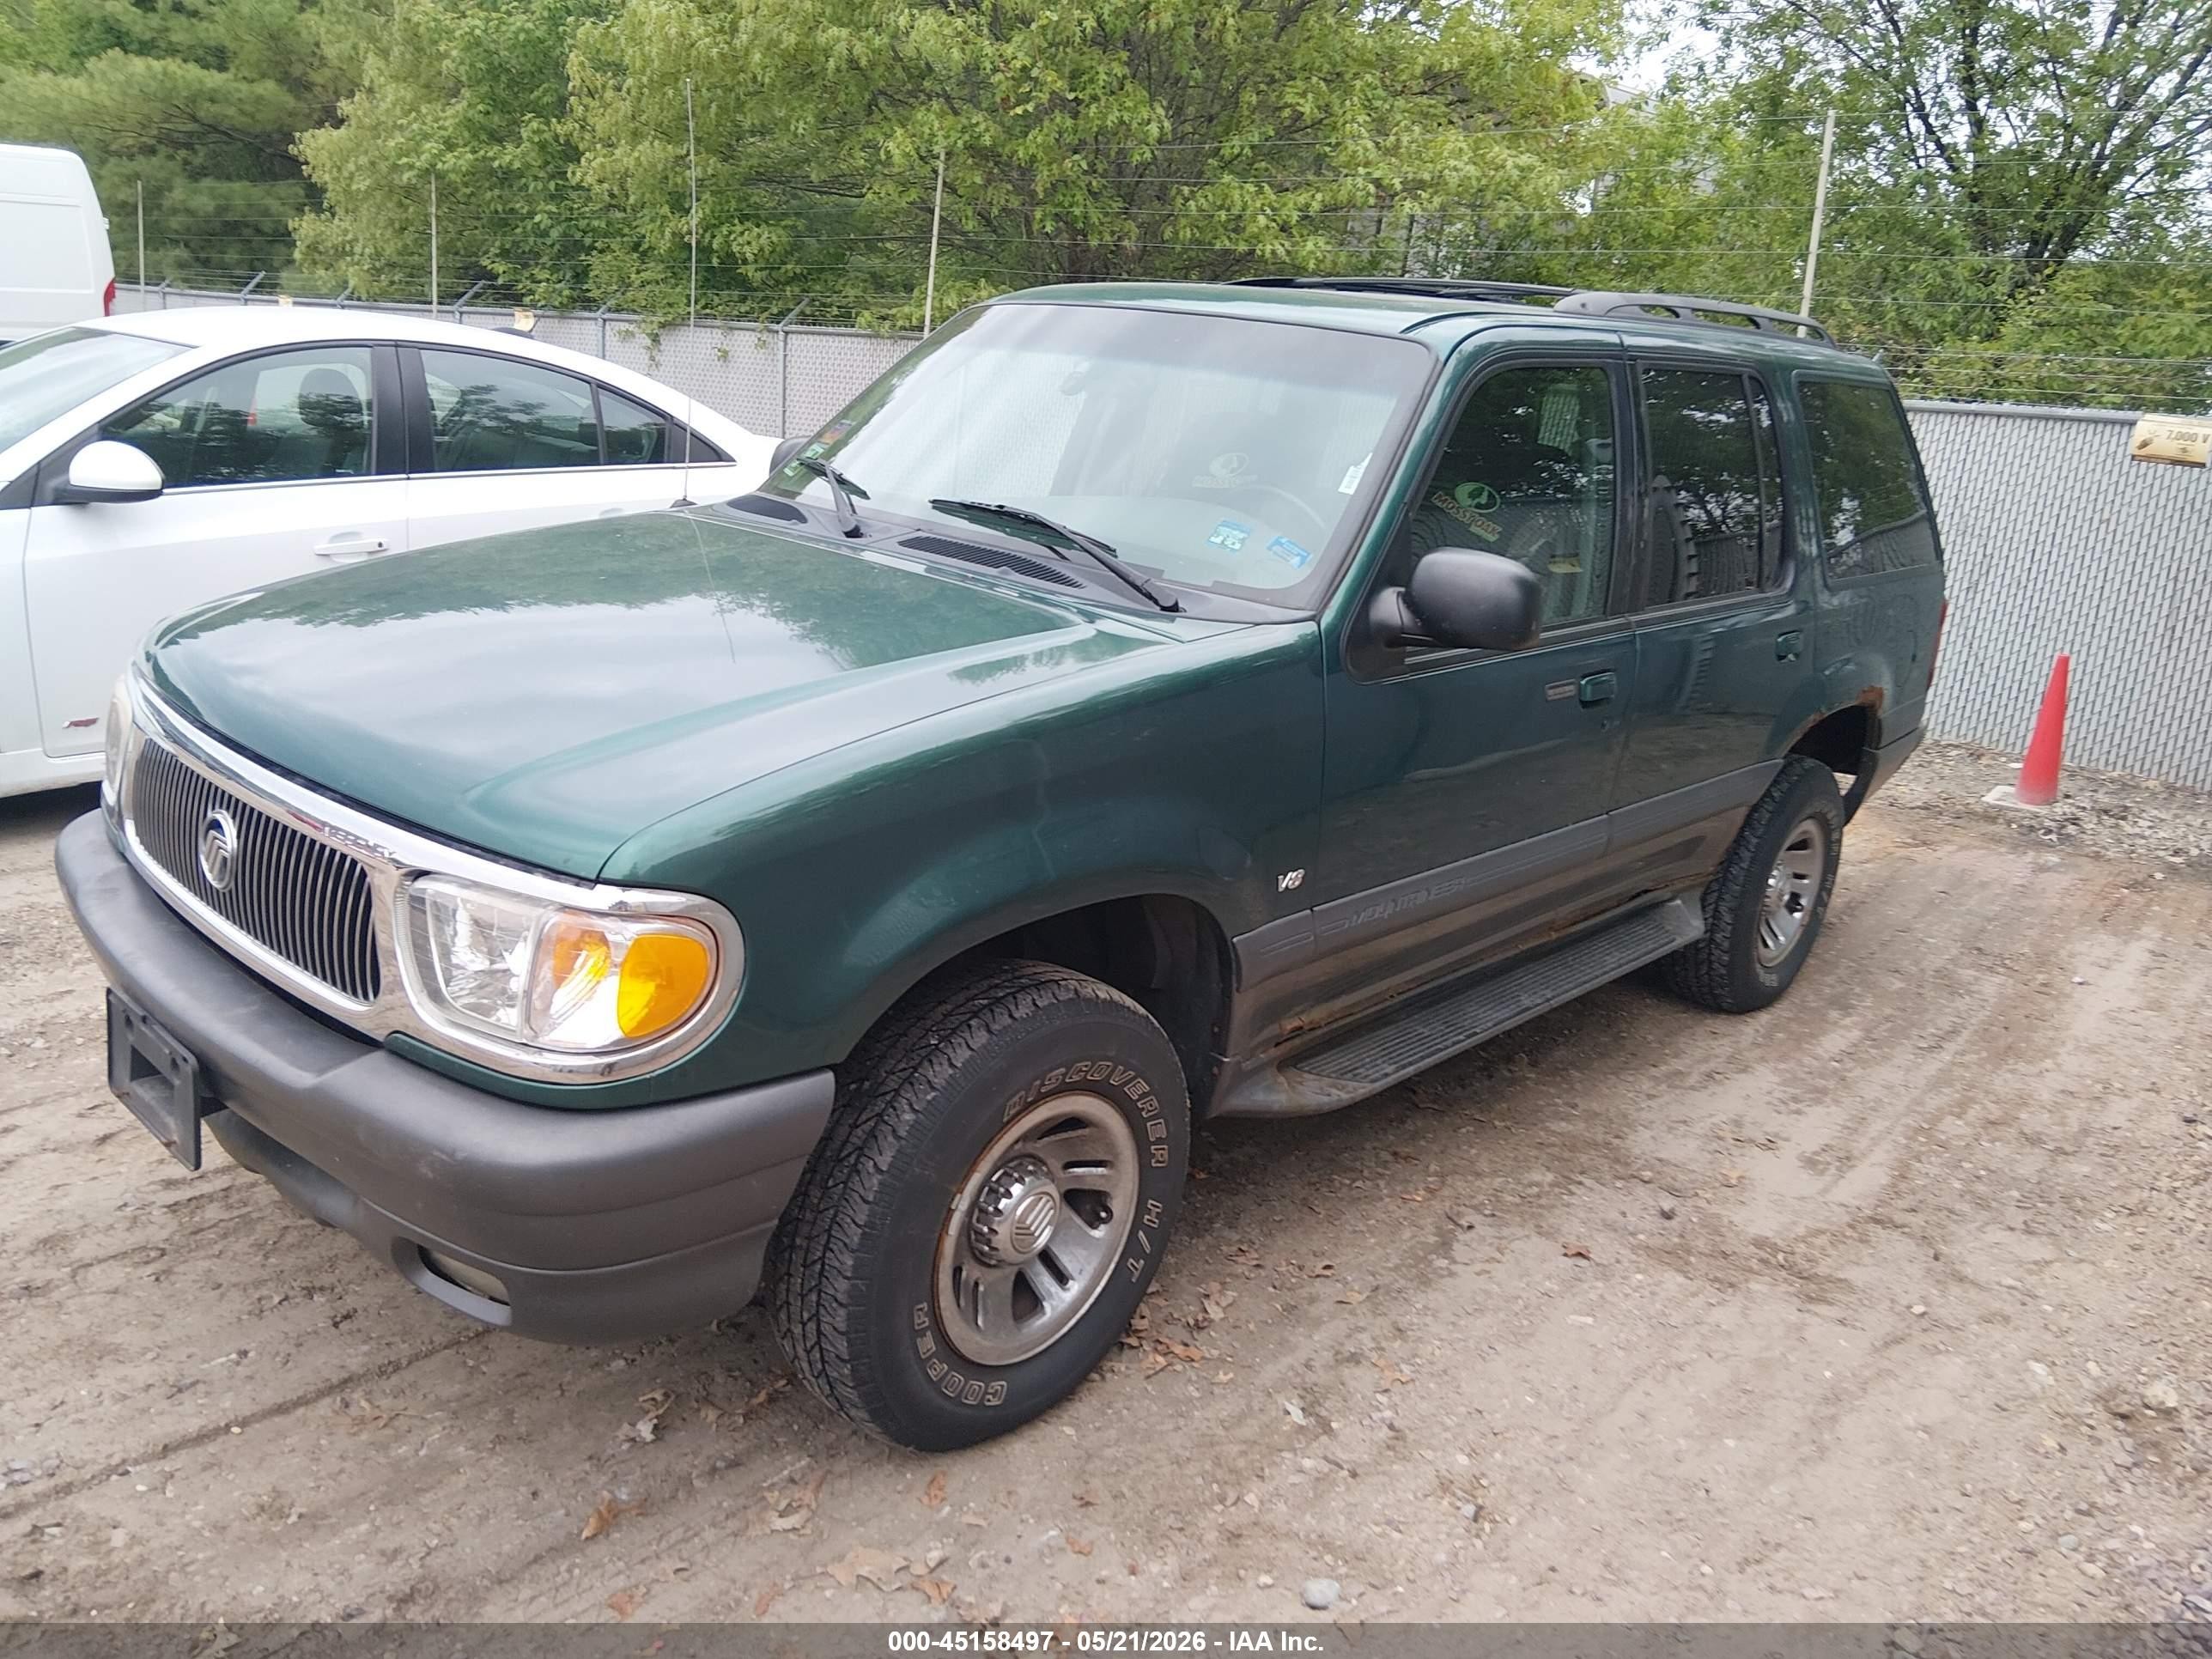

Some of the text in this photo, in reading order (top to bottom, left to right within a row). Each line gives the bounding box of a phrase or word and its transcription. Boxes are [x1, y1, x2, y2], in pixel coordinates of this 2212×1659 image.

[1277, 868, 1305, 892] V8
[1003, 1060, 1169, 1168] DISCOVERER
[1127, 1199, 1164, 1283] H/T
[913, 1302, 1007, 1407] COOPER
